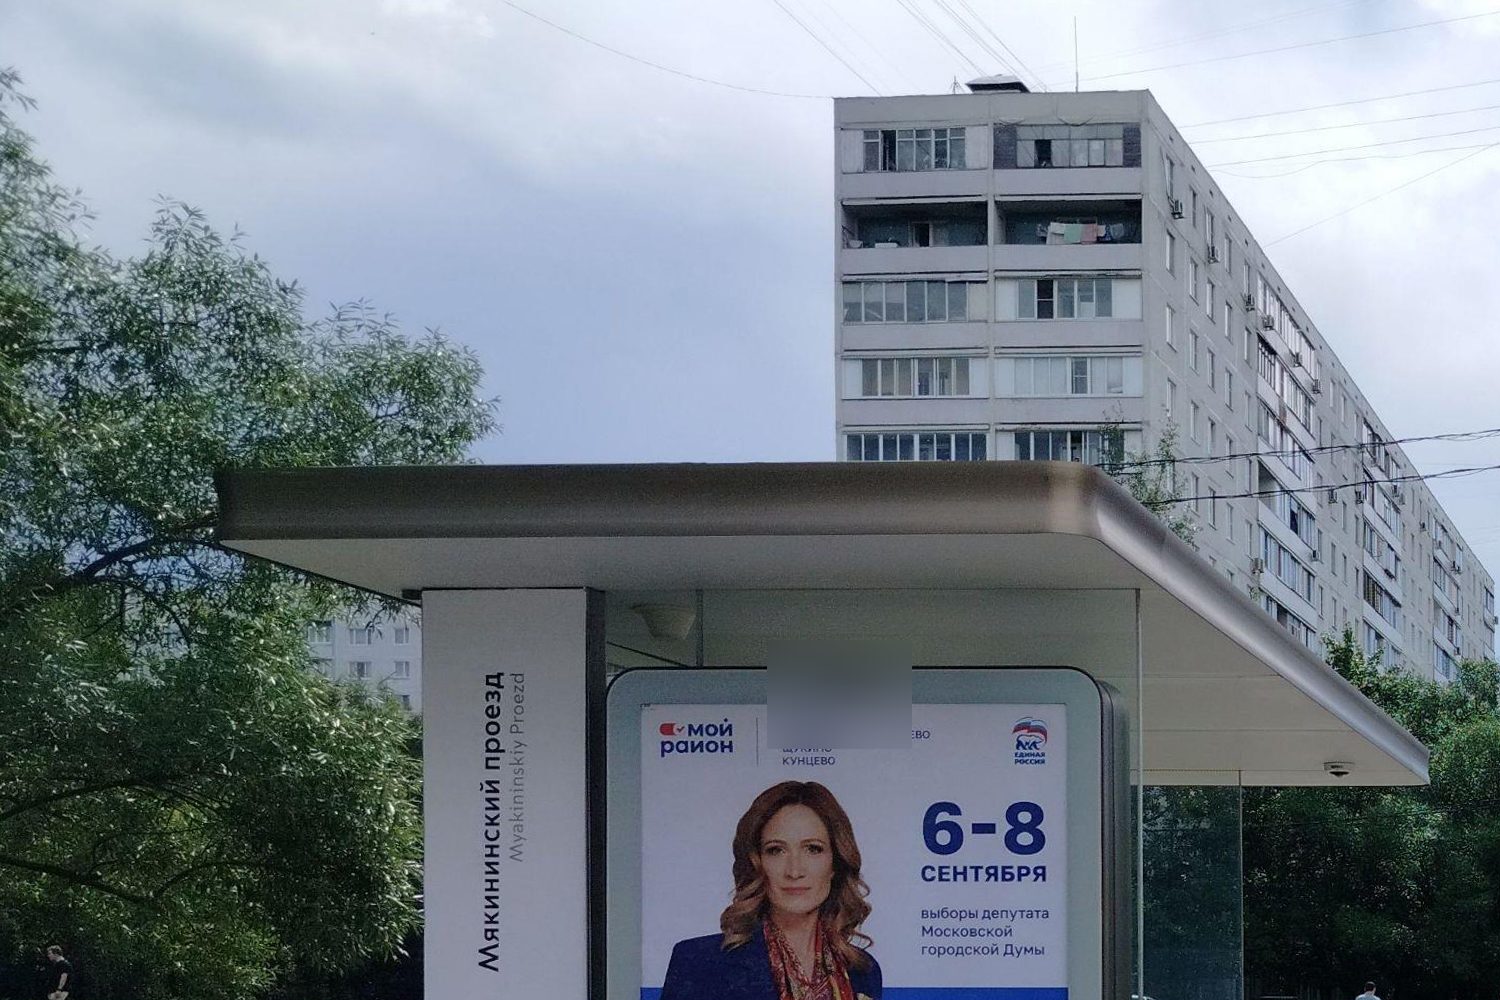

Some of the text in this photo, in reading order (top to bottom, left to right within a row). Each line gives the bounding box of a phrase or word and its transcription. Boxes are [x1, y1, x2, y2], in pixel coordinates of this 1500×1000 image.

[687, 717, 733, 737] мой
[660, 739, 734, 758] район
[509, 672, 528, 862] Myakininskiy Proezd
[782, 756, 836, 767] КУНЦЕВО
[477, 672, 506, 973] Мякининский проезд
[921, 864, 1047, 882] СЕНТЯБРЯ
[921, 906, 1050, 922] выборы депутата
[921, 924, 1013, 938] Московской
[921, 943, 1045, 959] городской Думы
